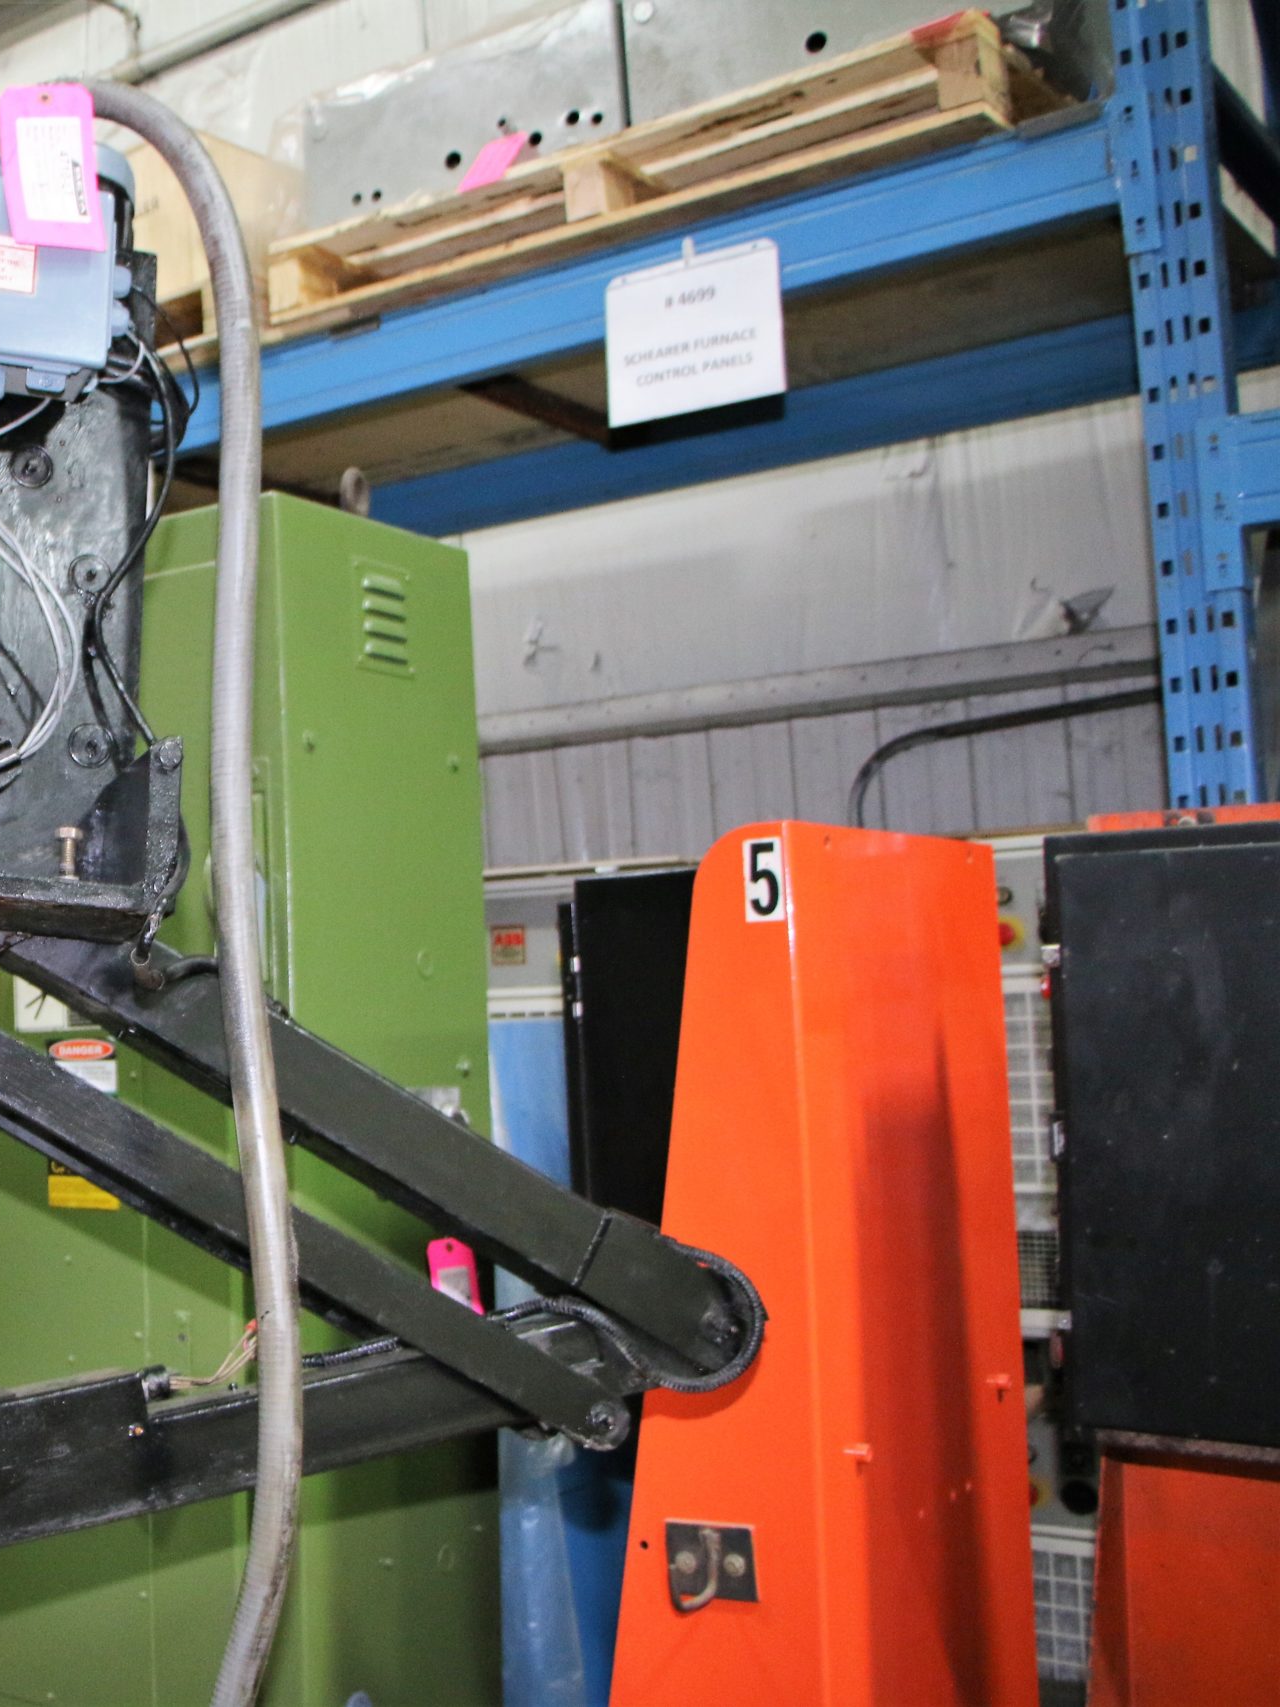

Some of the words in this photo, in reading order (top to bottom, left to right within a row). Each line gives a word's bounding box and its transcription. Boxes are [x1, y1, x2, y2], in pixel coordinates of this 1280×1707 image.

[664, 296, 673, 309] #
[678, 285, 716, 305] 4699
[623, 341, 690, 367] SCHEARER
[693, 327, 757, 352] FURNACE
[636, 365, 698, 388] CONTROL
[702, 351, 754, 374] PANELS
[751, 842, 779, 916] 5
[495, 934, 523, 946] ABB
[59, 1044, 104, 1056] DANGER
